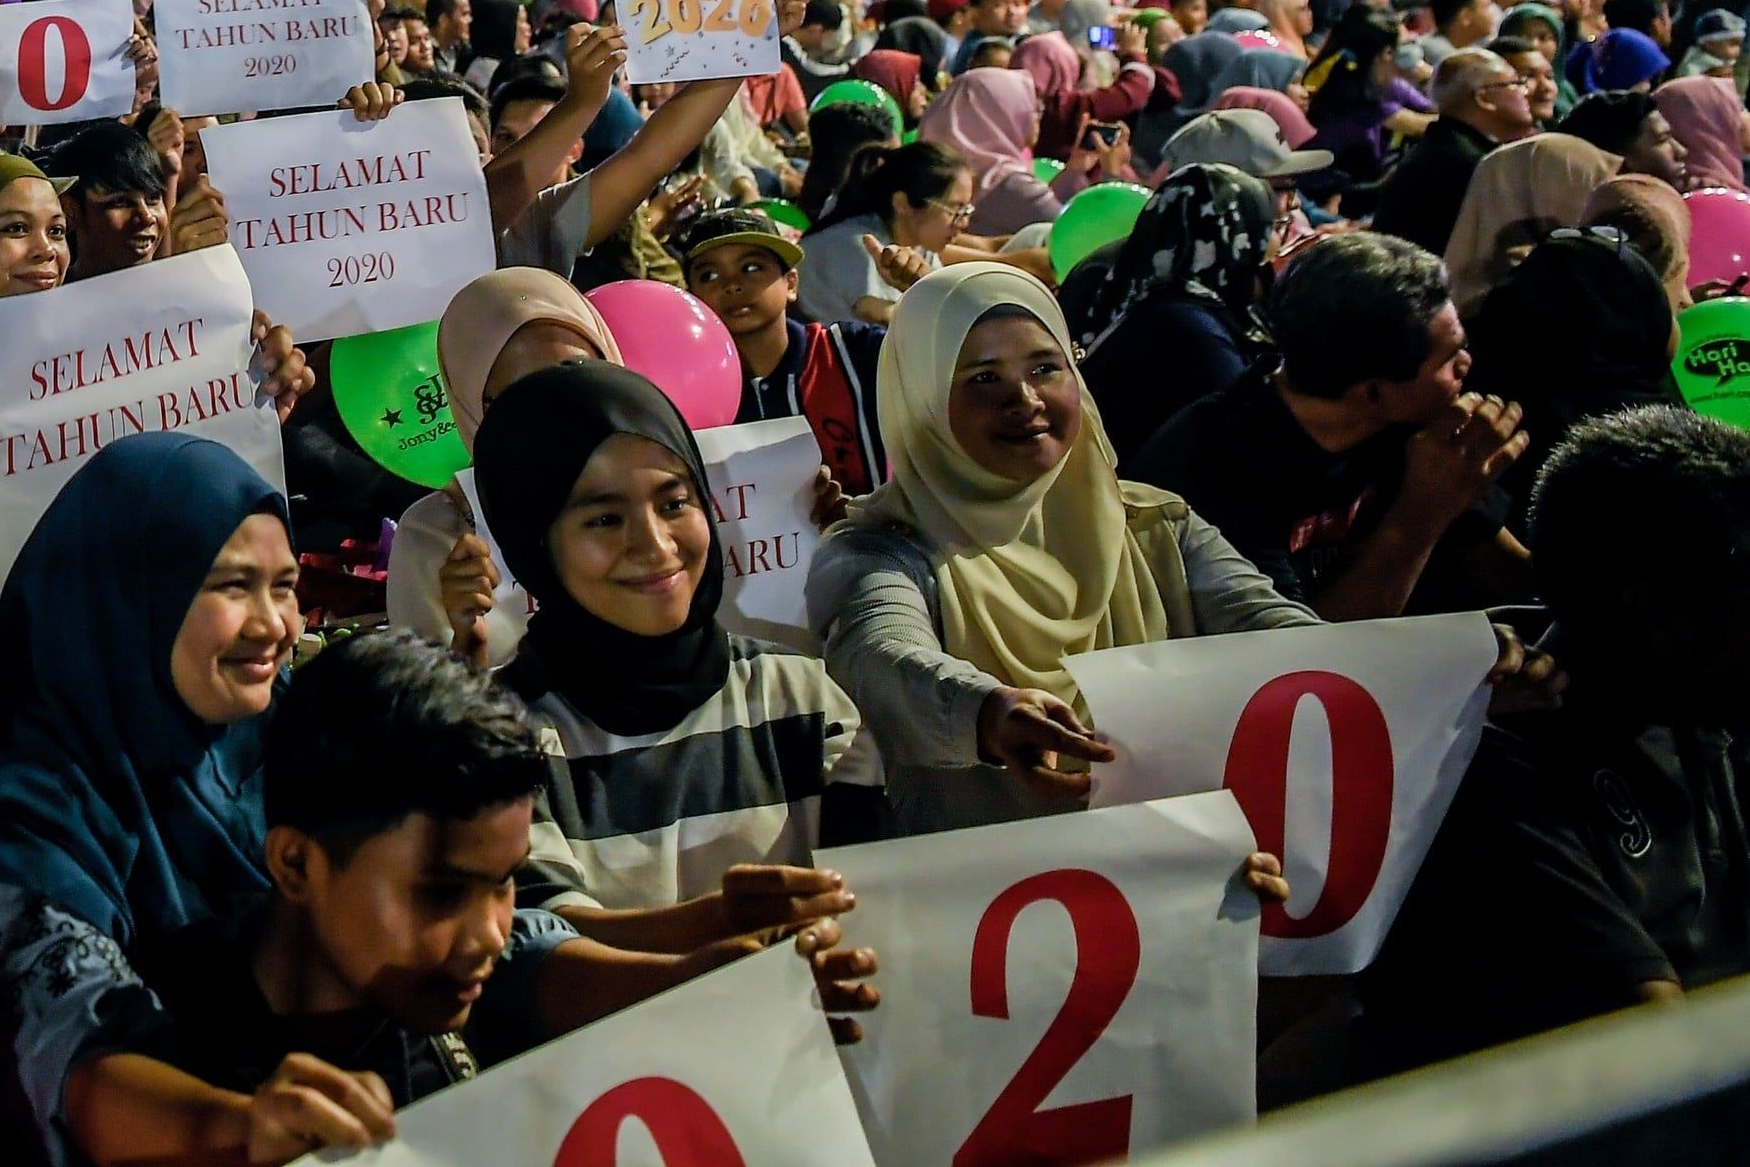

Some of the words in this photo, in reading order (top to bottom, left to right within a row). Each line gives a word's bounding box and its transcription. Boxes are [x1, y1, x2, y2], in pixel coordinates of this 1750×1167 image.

[175, 18, 279, 51] TAHUN
[285, 14, 357, 42] BARU
[17, 15, 92, 112] 0
[244, 54, 297, 79] 2020
[269, 149, 432, 198] SELAMAT
[236, 206, 370, 250] TAHUN
[378, 191, 470, 232] BARU
[327, 251, 396, 289] 2020
[28, 318, 204, 402] SELAMAT
[1690, 342, 1738, 366] Hari
[156, 369, 254, 431] BARU
[1223, 670, 1394, 939] 0
[953, 868, 1140, 1167] 2
